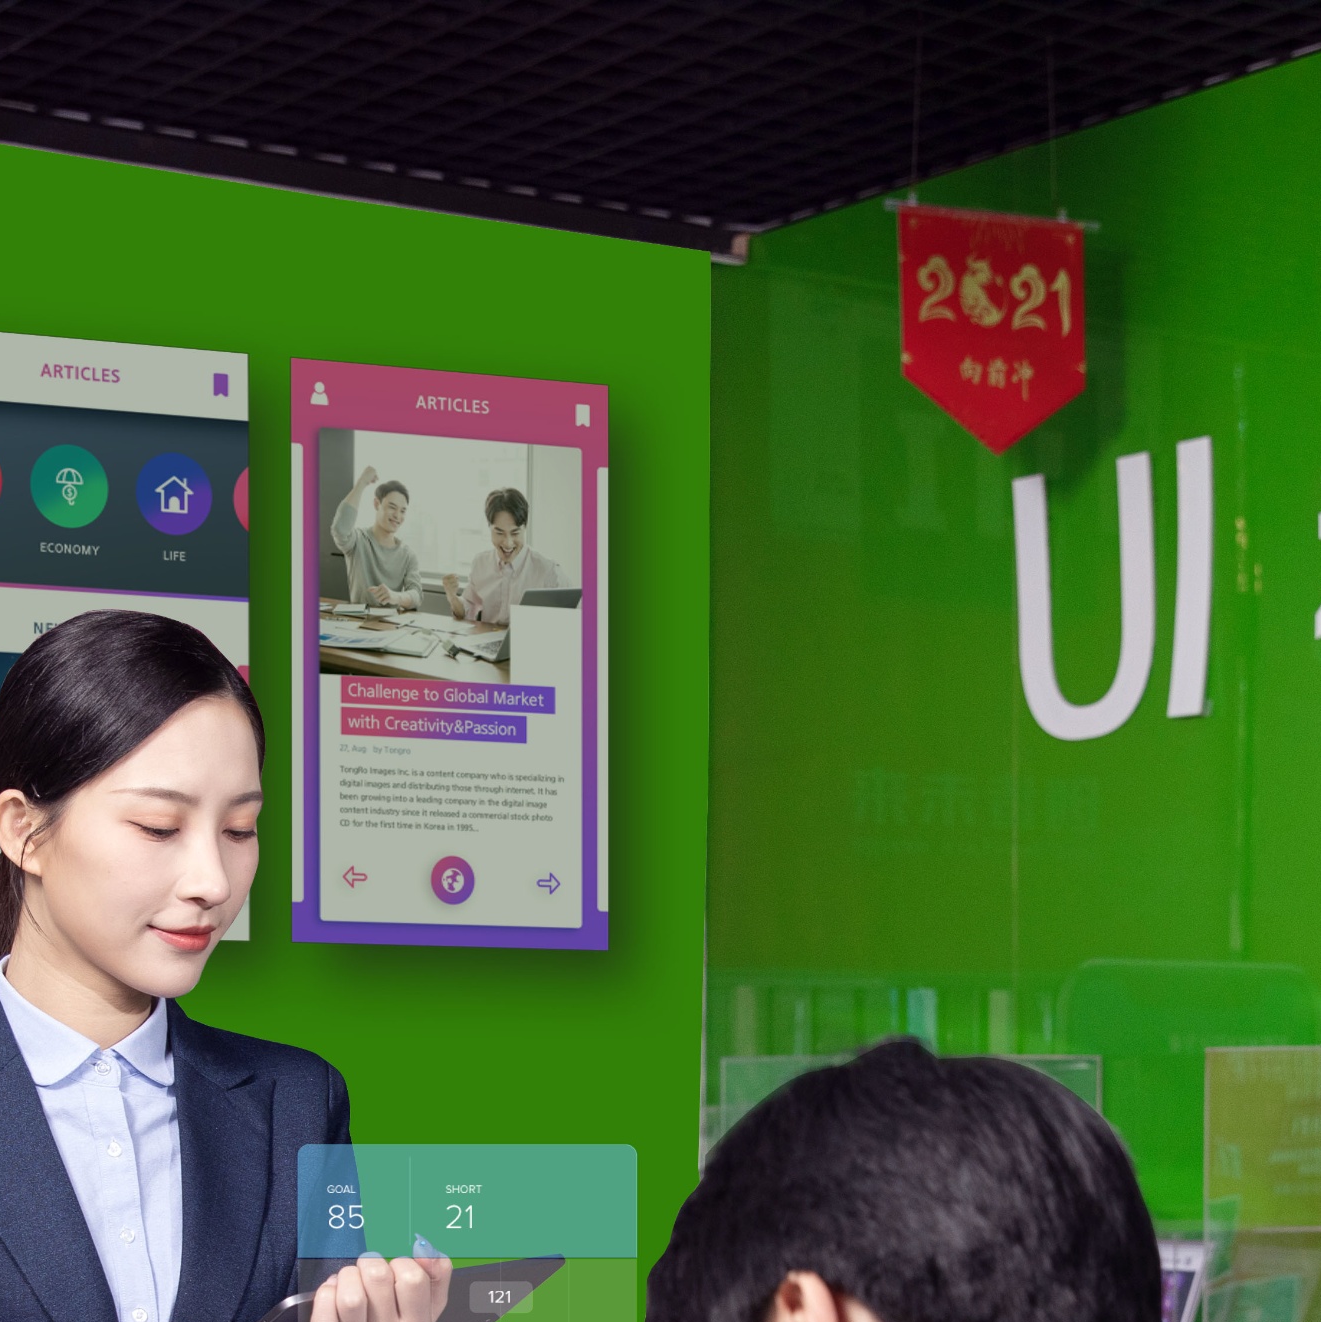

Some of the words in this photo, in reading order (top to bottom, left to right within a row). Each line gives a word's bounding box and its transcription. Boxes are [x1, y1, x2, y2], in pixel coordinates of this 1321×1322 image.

[40, 363, 121, 384] ARTICLES
[959, 355, 1035, 401] 向前冲
[415, 395, 490, 415] ARTICLES
[39, 542, 100, 556] ECONOMY
[163, 550, 187, 562] LIFE
[348, 683, 419, 702] Challenge
[424, 688, 439, 701] to
[444, 688, 488, 704] Global
[493, 691, 544, 707] Market
[348, 715, 380, 730] with
[385, 716, 516, 736] Creativity&Passion
[352, 745, 367, 754] Aug
[373, 745, 382, 754] by
[370, 767, 396, 776] Images
[426, 769, 454, 777] content
[456, 772, 488, 780] company
[392, 781, 406, 789] and
[452, 784, 472, 792] those
[545, 788, 557, 796] has
[340, 792, 358, 800] been
[340, 806, 368, 815] content
[402, 808, 420, 816] since
[365, 820, 378, 828] the
[424, 822, 445, 831] Korea
